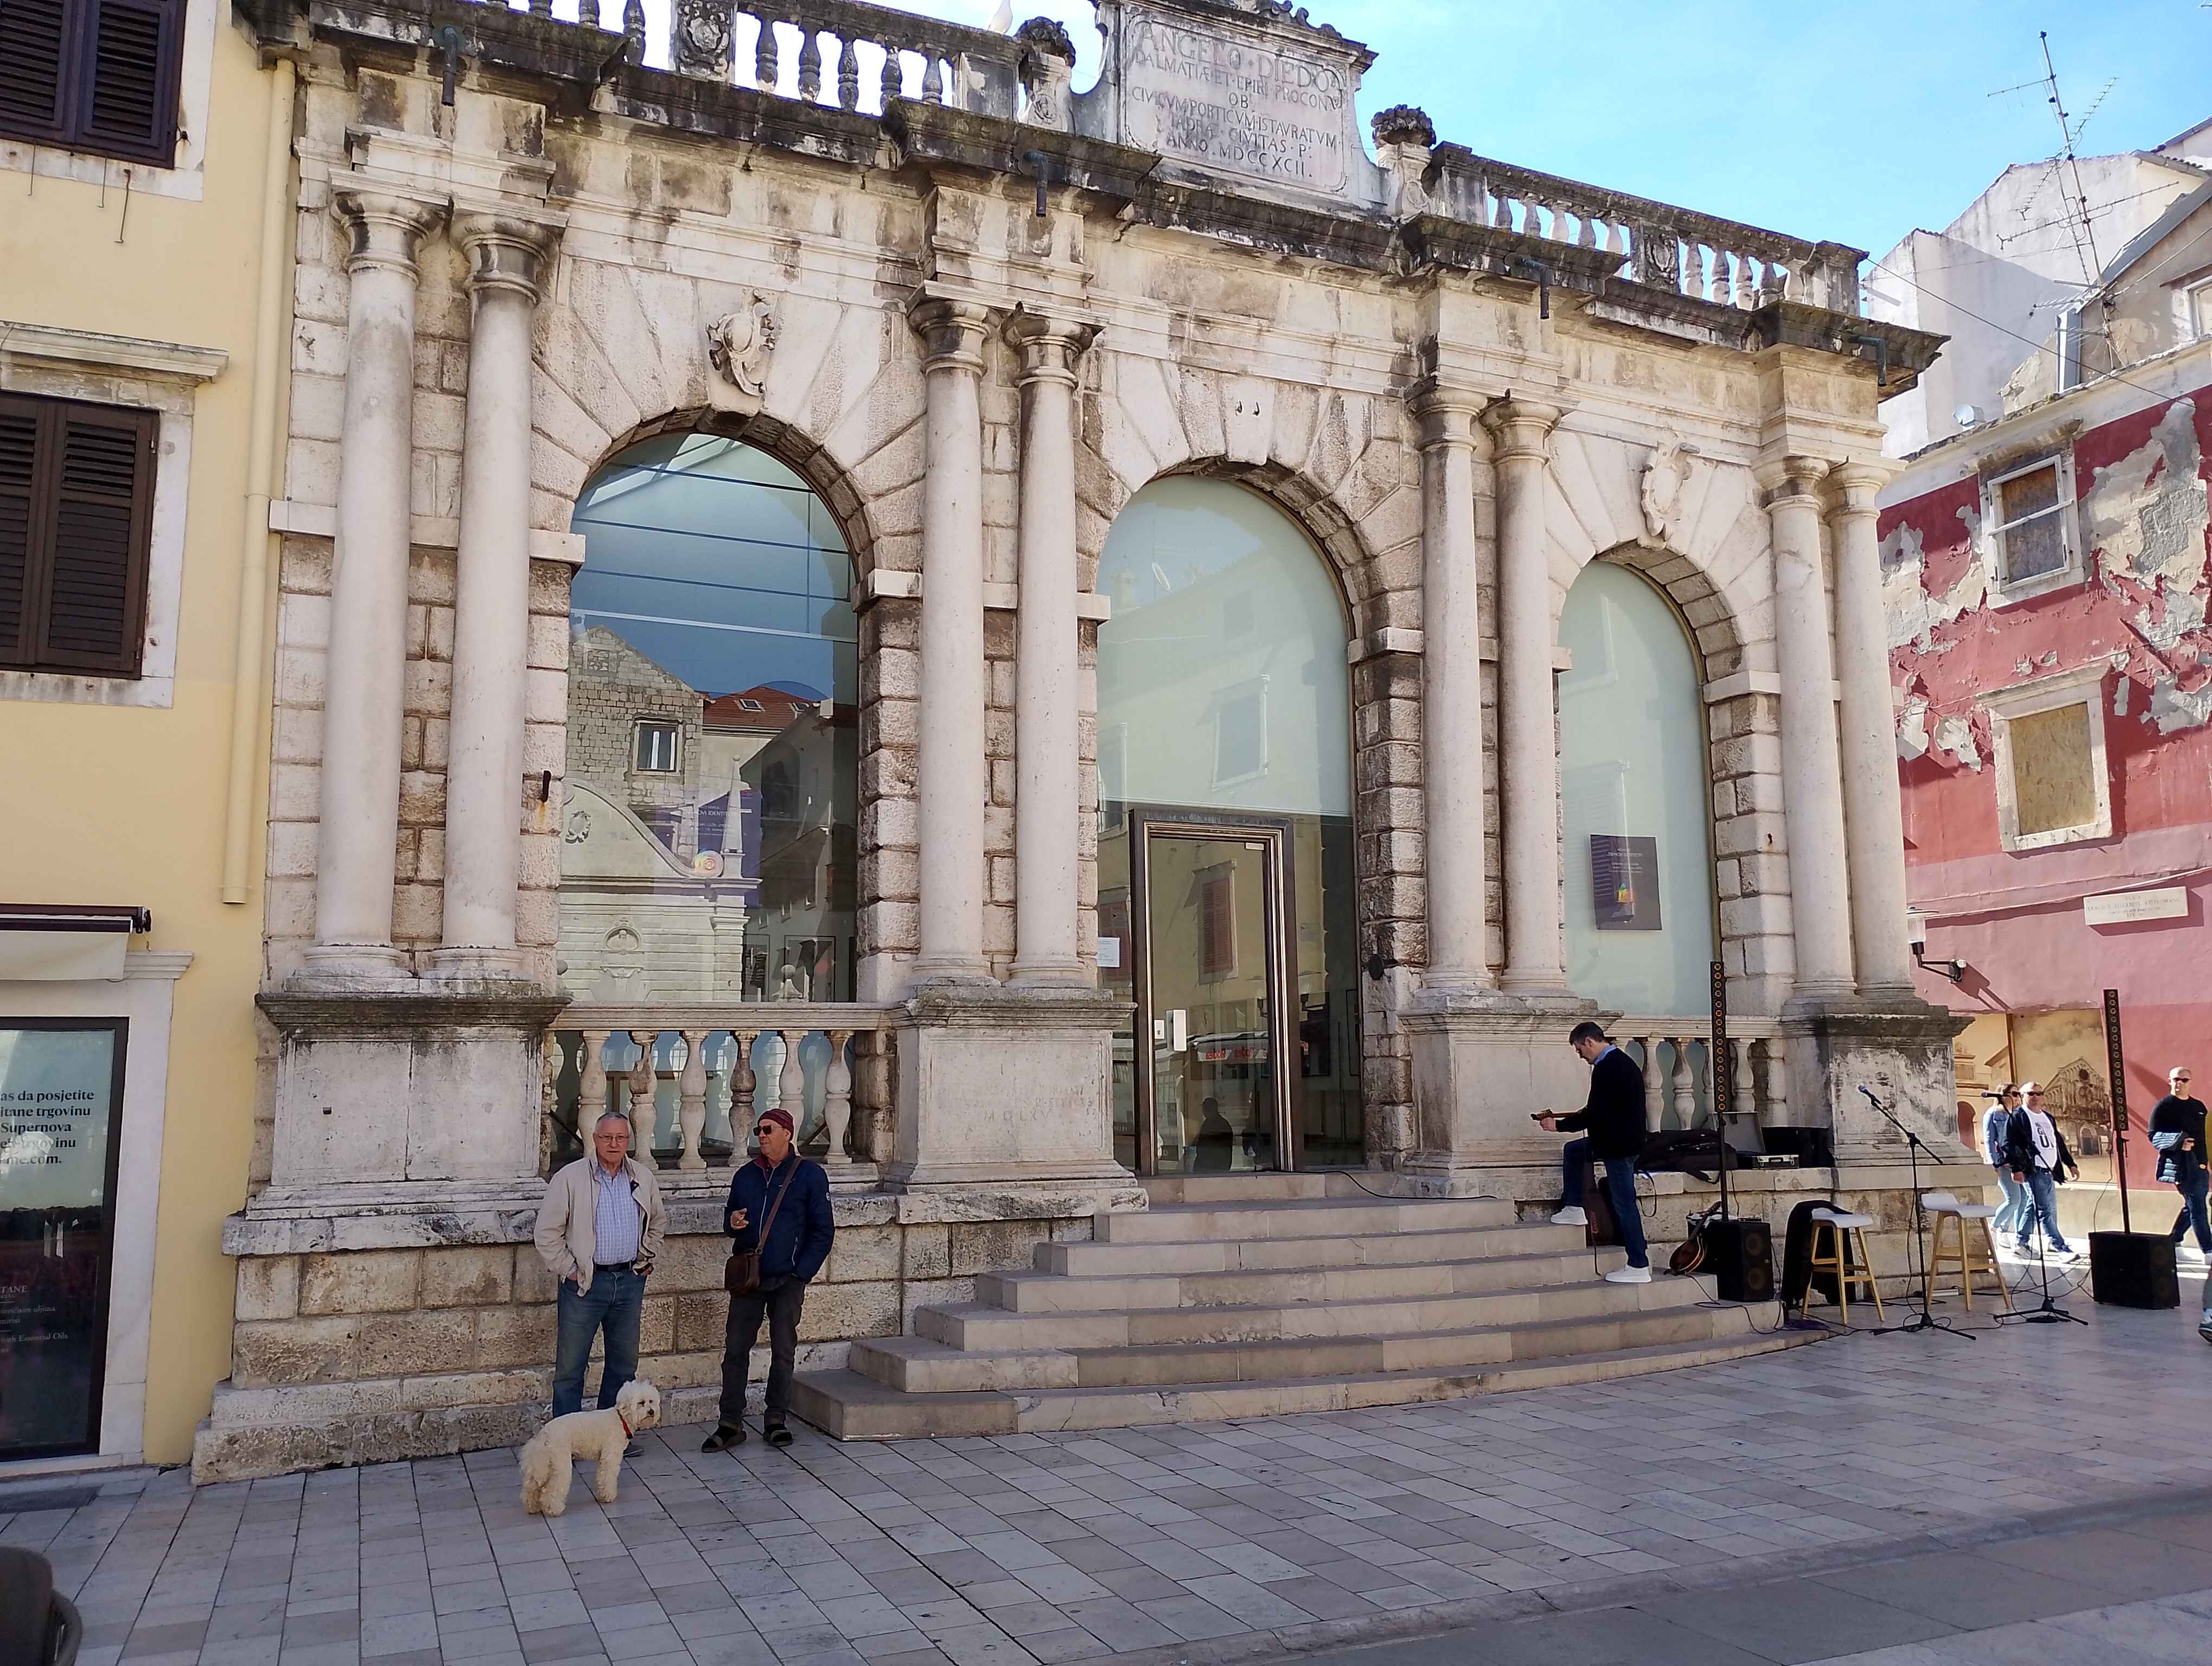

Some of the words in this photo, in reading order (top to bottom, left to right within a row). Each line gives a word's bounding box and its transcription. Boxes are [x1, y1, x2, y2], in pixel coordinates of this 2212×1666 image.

[1135, 24, 1240, 69] ANGELO
[1167, 133, 1208, 152] ANNO
[1229, 128, 1287, 153] CIVITAS
[18, 1091, 33, 1101] da
[36, 1090, 94, 1103] posjetite
[1, 1106, 33, 1117] itane
[36, 1106, 91, 1118] trgovinu
[1, 1123, 72, 1135] Supernova
